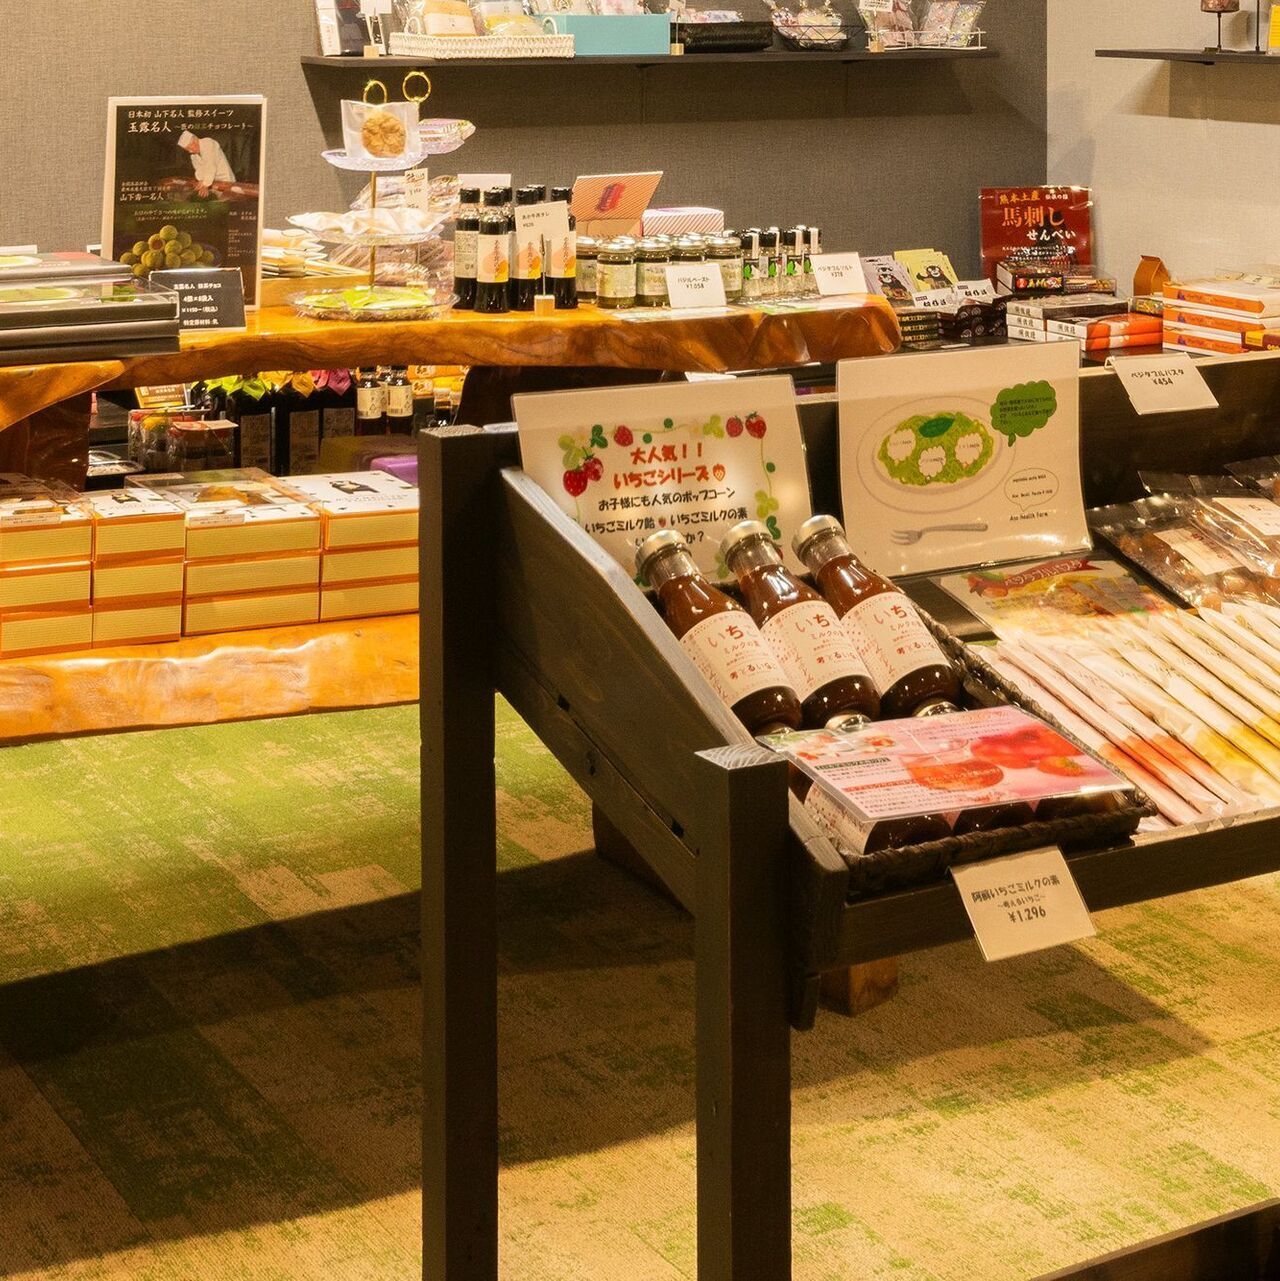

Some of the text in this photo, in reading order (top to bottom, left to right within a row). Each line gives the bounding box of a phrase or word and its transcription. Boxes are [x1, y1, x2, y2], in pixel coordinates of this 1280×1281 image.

[1001, 205, 1065, 228] 馬刺し
[1026, 228, 1077, 241] せんべい
[613, 463, 710, 490] いちごシリーズ
[597, 486, 736, 512] お子様にも人気のポップコーン
[669, 505, 749, 526] いちごミルクの素
